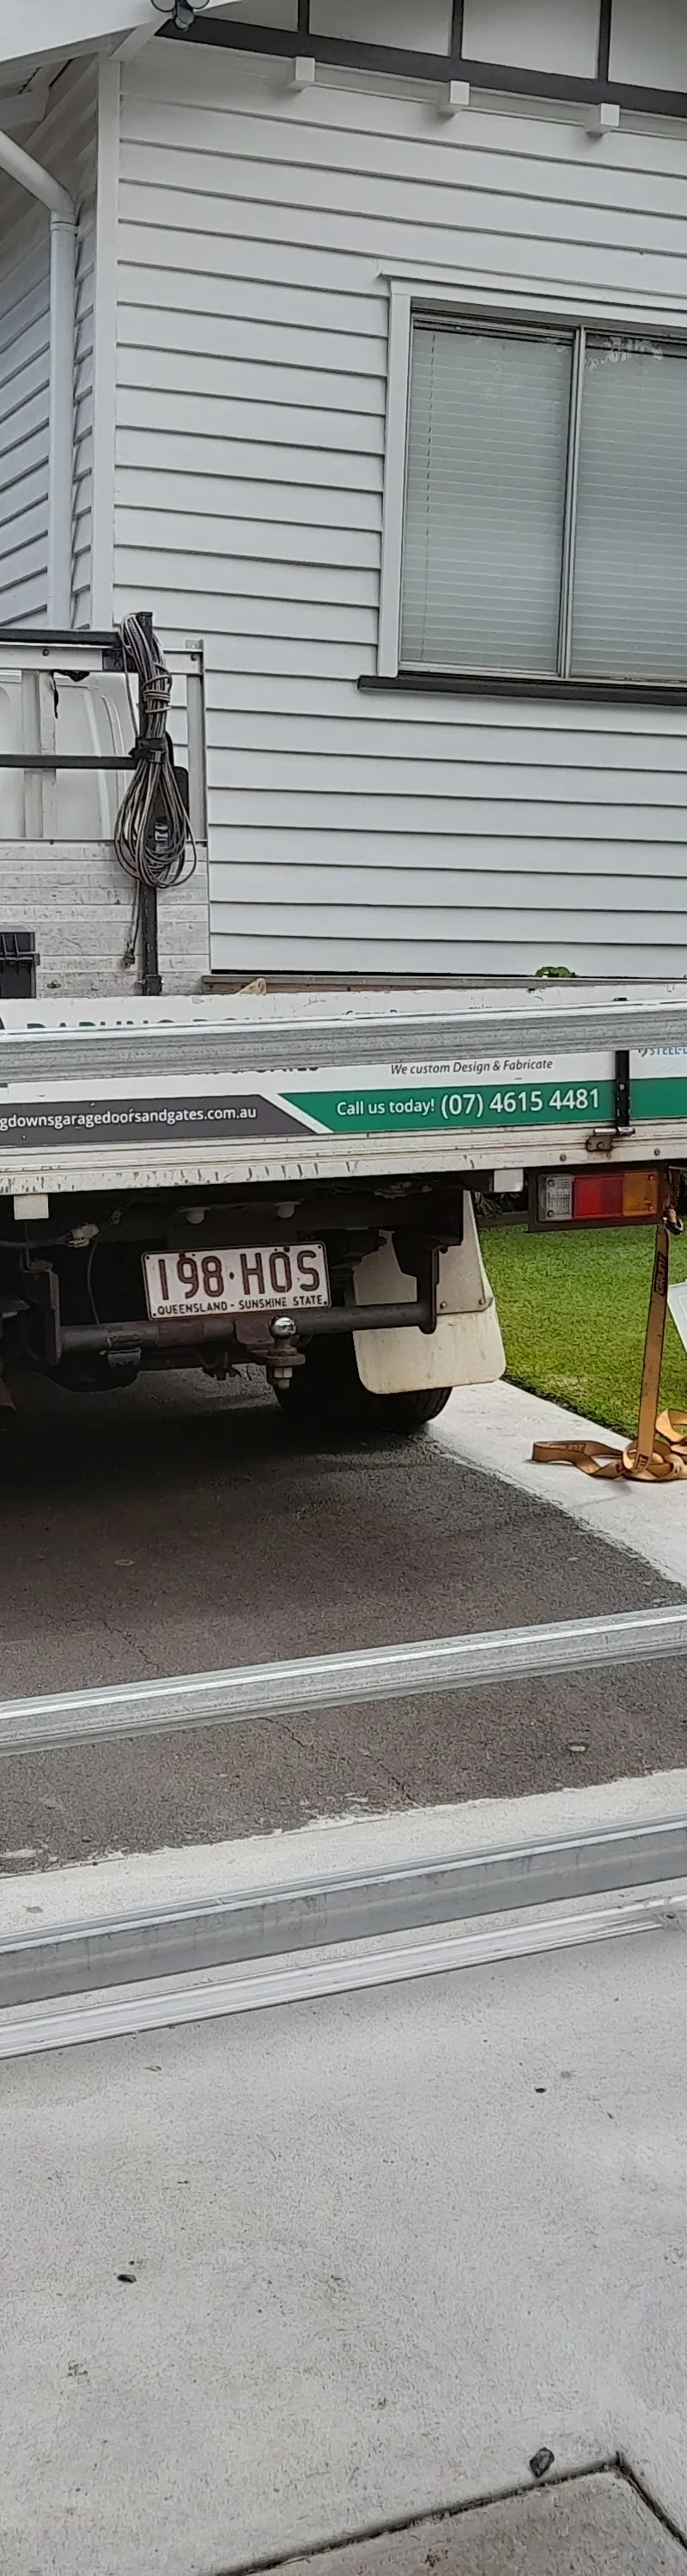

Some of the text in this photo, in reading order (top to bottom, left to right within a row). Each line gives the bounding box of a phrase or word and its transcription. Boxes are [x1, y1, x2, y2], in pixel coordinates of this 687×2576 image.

[391, 1058, 554, 1075] We custom Design & Fabricate
[336, 1087, 600, 1120] Call us today! (07) 4615 4481
[157, 1300, 228, 1315] QUEENSLAND
[239, 1297, 288, 1309] SUNSHINE
